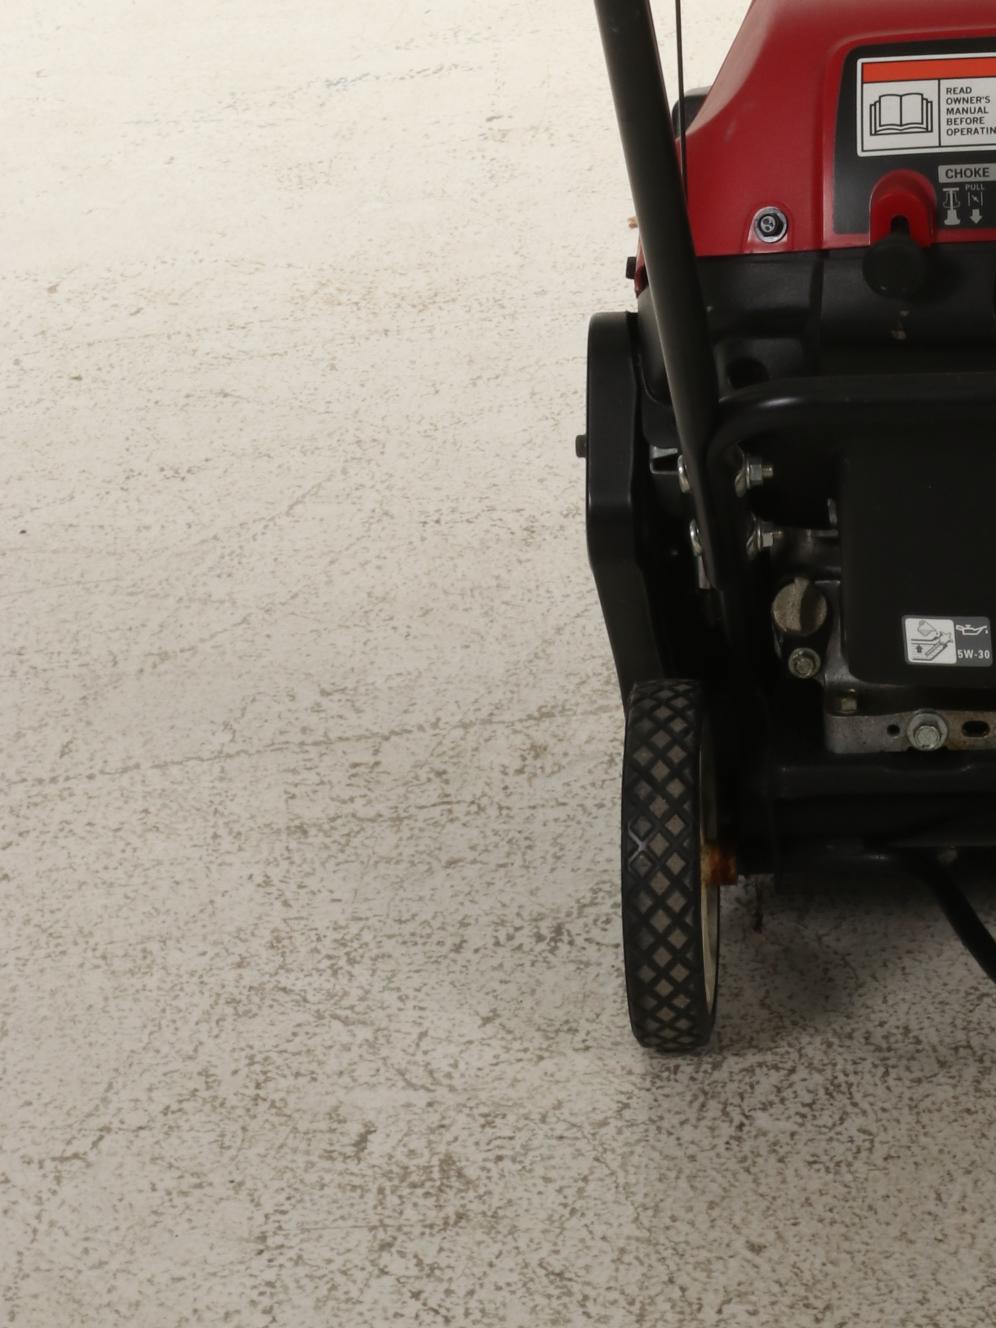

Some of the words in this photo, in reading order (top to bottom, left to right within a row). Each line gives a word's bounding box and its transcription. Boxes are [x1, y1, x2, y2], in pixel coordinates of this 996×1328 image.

[946, 87, 972, 95] READ
[946, 96, 991, 104] OWNER'S
[946, 106, 989, 115] MANUAL
[946, 116, 985, 125] BEFORE
[945, 167, 990, 179] CHOKE
[958, 649, 990, 660] 5W-30
